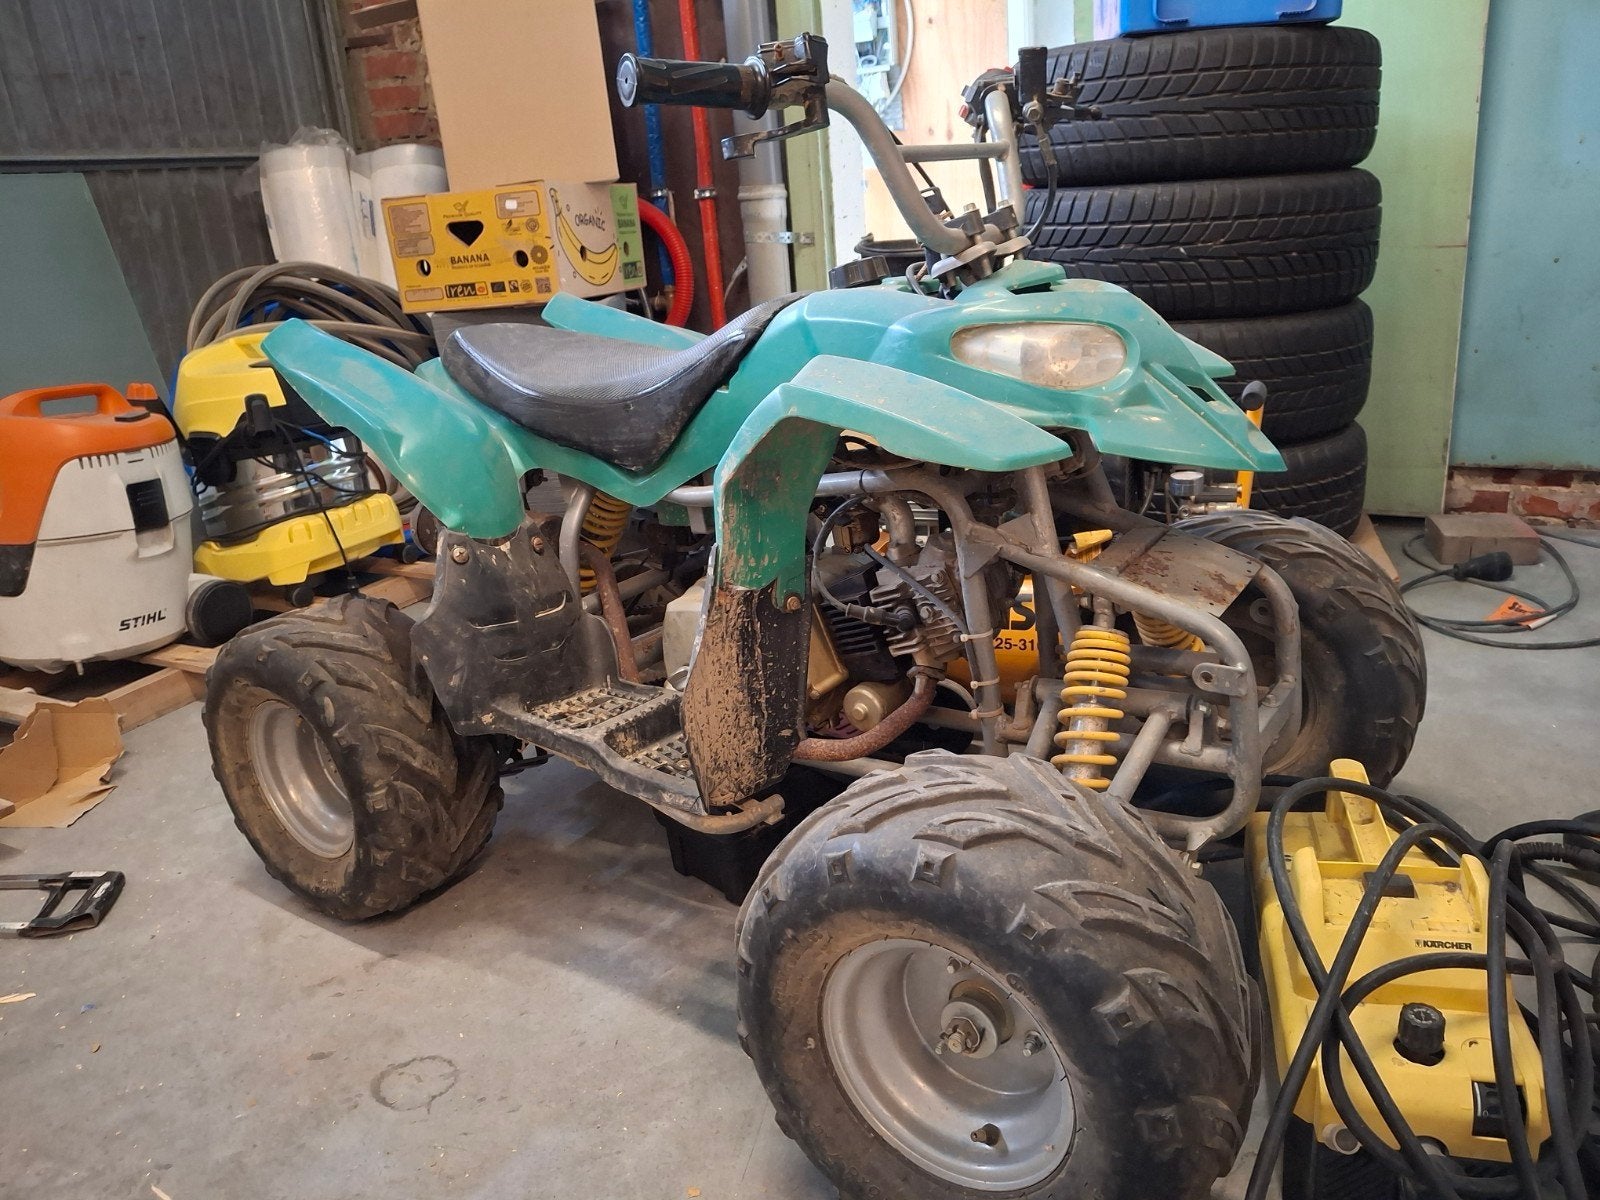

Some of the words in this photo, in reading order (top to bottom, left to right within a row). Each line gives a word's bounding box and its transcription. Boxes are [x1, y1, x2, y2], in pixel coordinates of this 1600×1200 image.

[575, 212, 605, 231] ORGANIC
[450, 253, 490, 265] BANANA
[119, 609, 166, 631] STIHL
[994, 637, 1035, 651] 25-31
